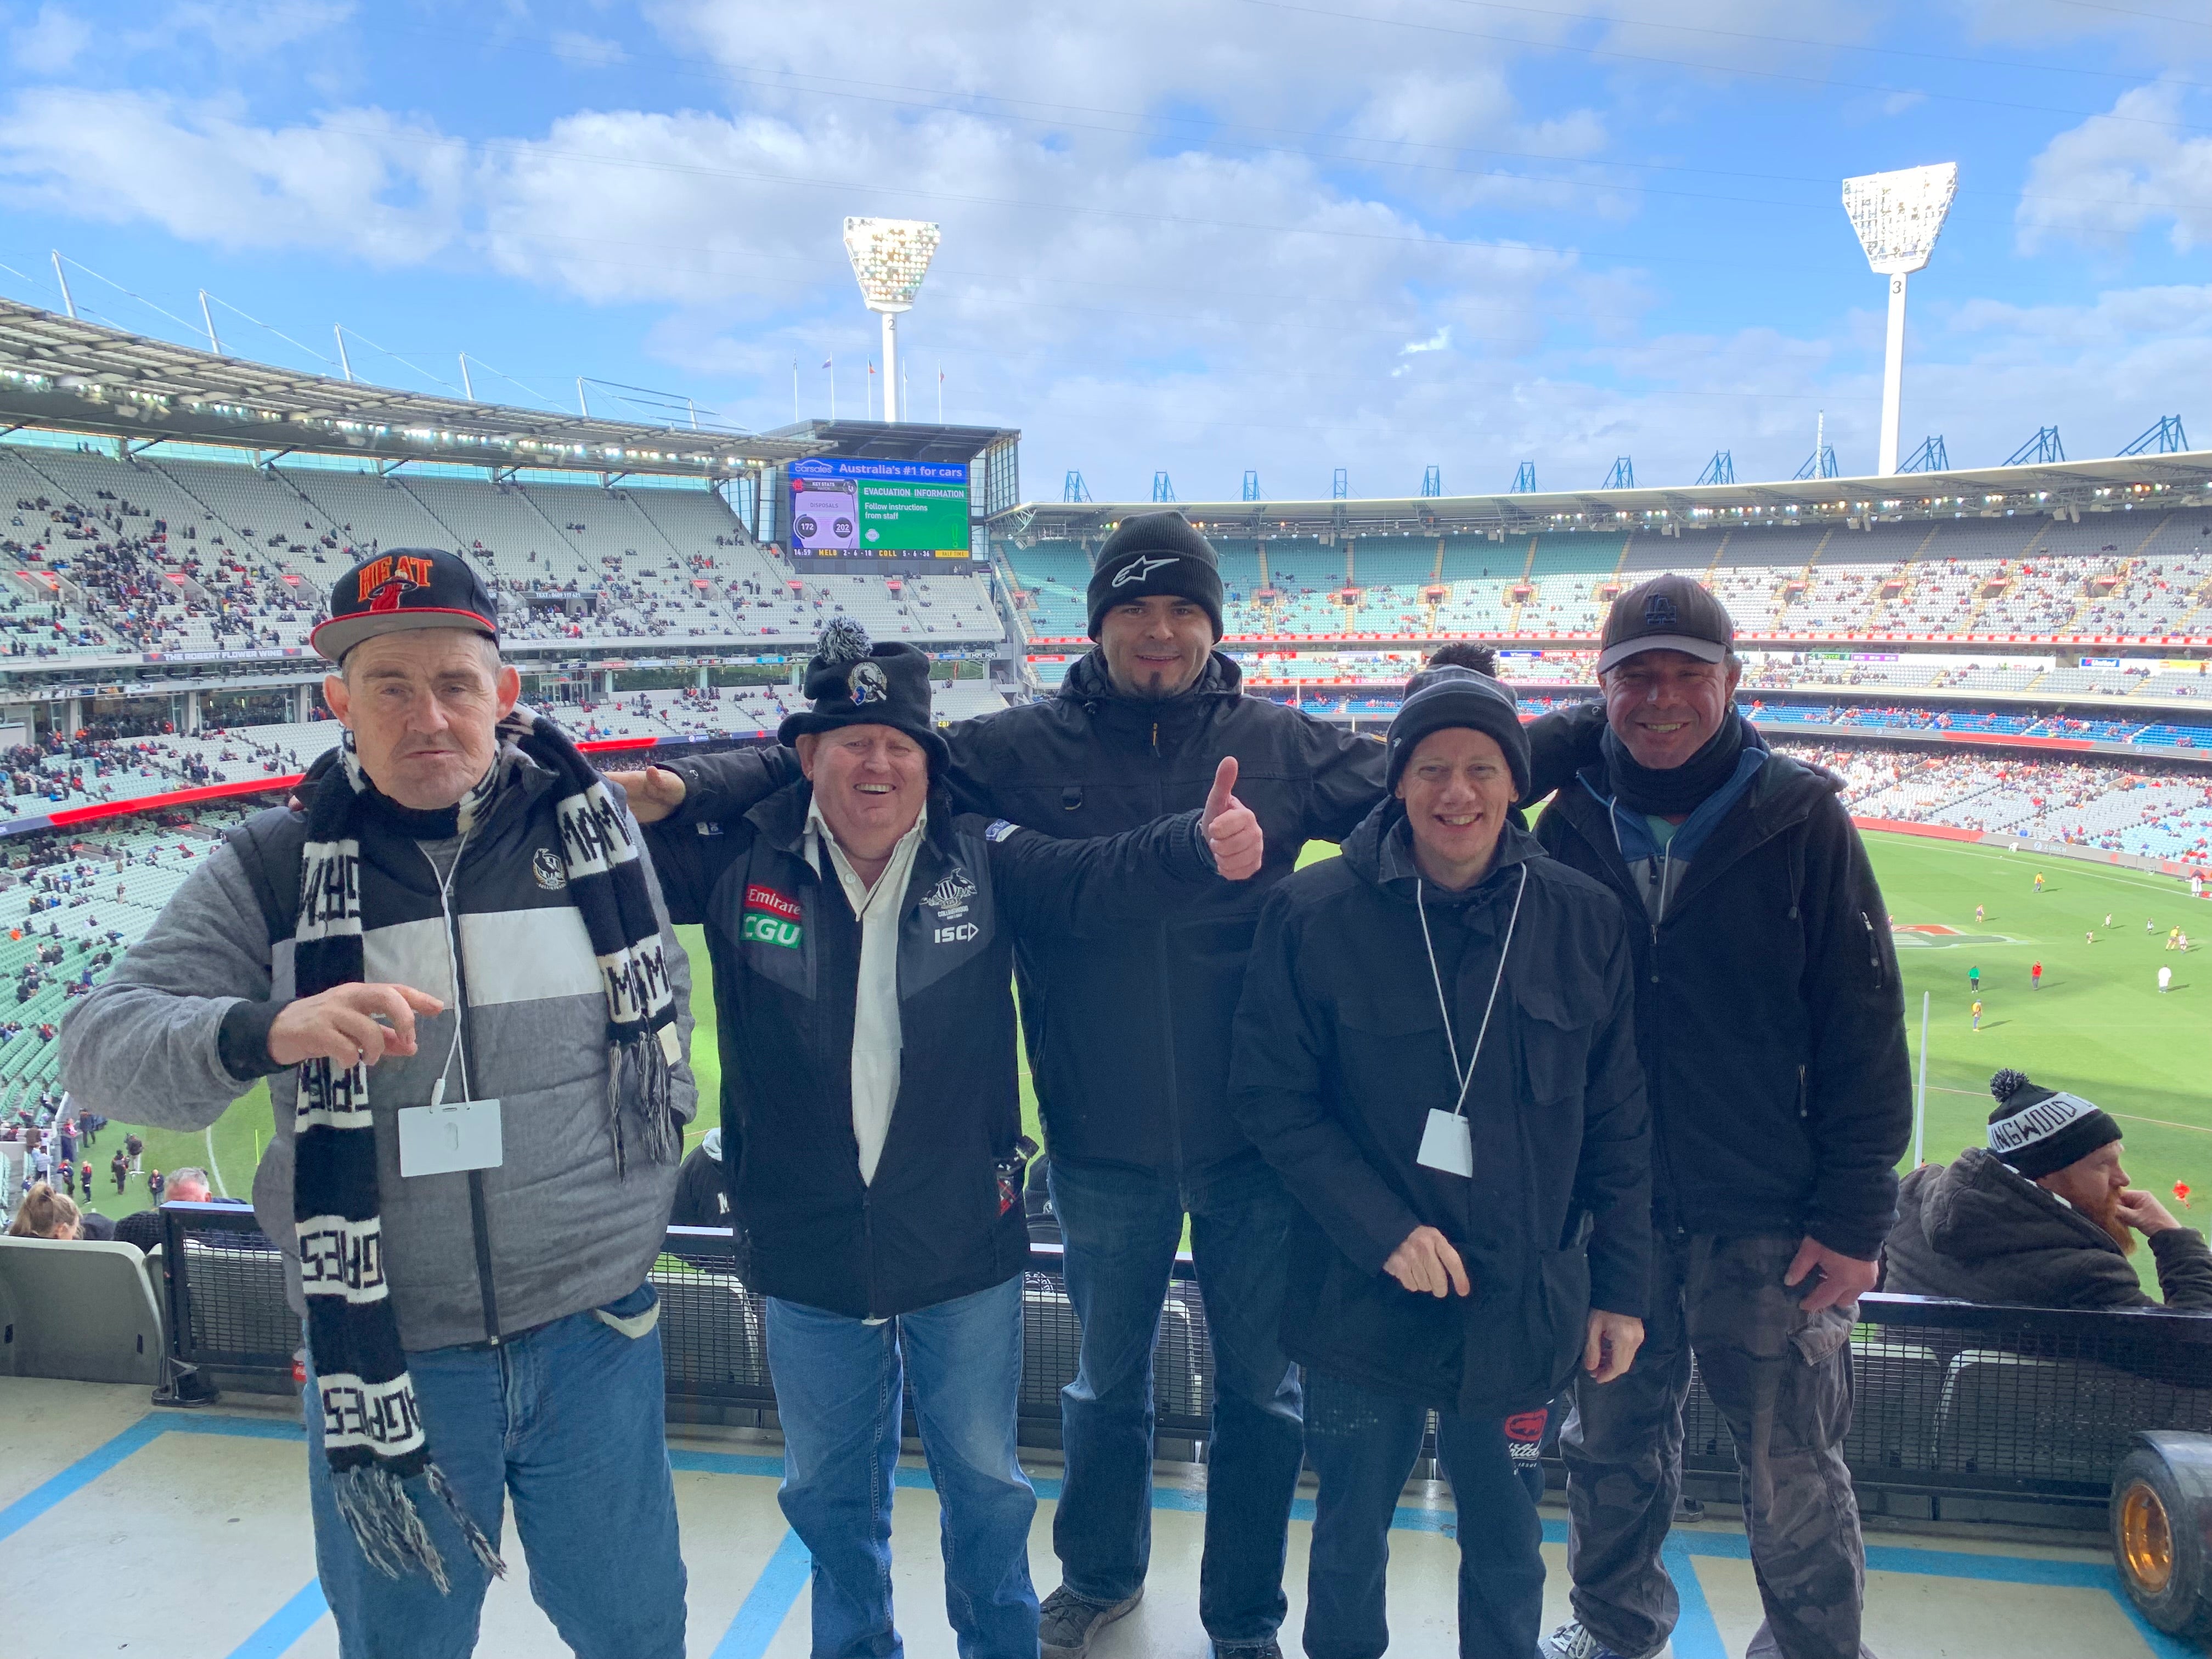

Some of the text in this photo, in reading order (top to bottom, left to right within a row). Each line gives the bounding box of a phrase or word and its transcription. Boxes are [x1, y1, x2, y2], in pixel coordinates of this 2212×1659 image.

[1893, 280, 1901, 294] 3
[888, 319, 895, 330] 2
[795, 465, 832, 473] carsales
[839, 464, 900, 475] Australia's
[919, 467, 936, 476] for
[864, 487, 964, 498] EVACUATION INFORMATION
[865, 503, 928, 511] Follow instructions
[358, 555, 433, 602] HEAT
[184, 652, 221, 660] ROBERT
[2044, 844, 2067, 853] ZURICH
[748, 888, 801, 916] Emirate
[934, 924, 968, 944] ISC
